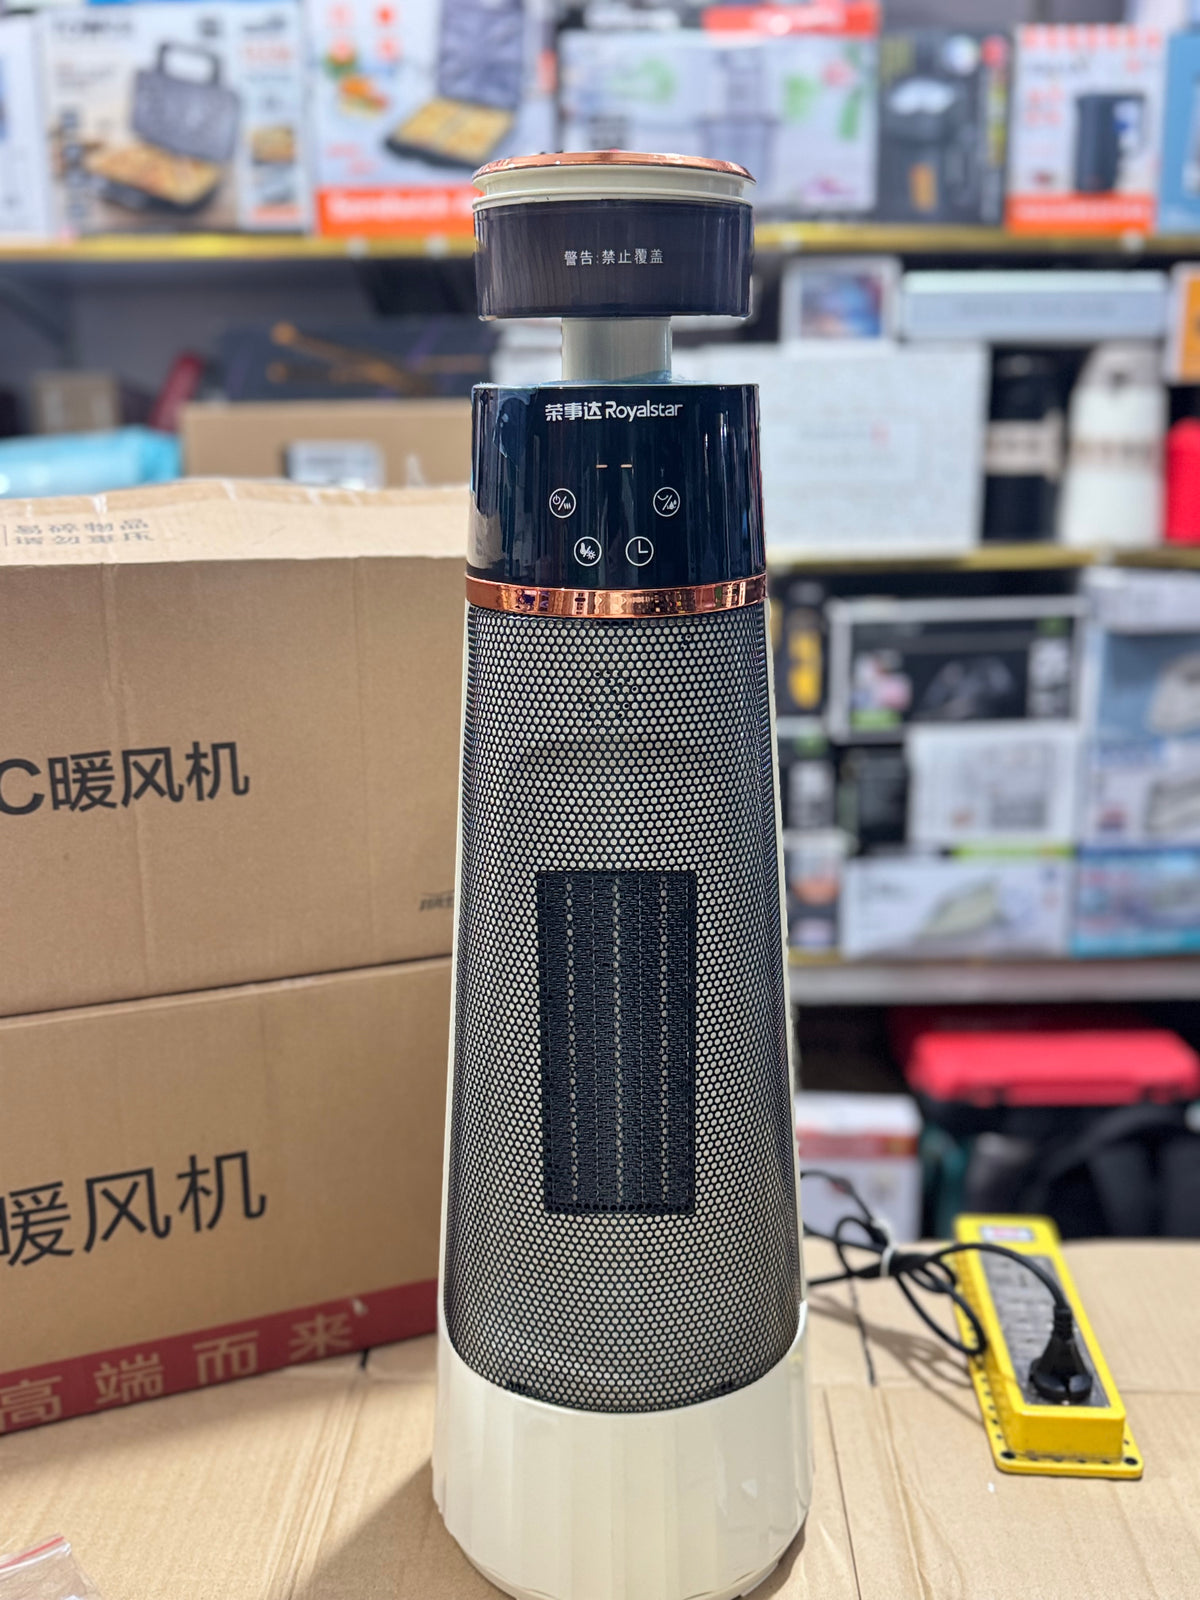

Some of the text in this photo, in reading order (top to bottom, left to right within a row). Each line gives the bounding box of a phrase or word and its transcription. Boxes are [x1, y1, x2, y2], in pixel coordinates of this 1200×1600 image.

[545, 400, 683, 422] 荣事达 Royalstar
[0, 1150, 267, 1266] 暖风机
[0, 1313, 351, 1431] 高端而来
